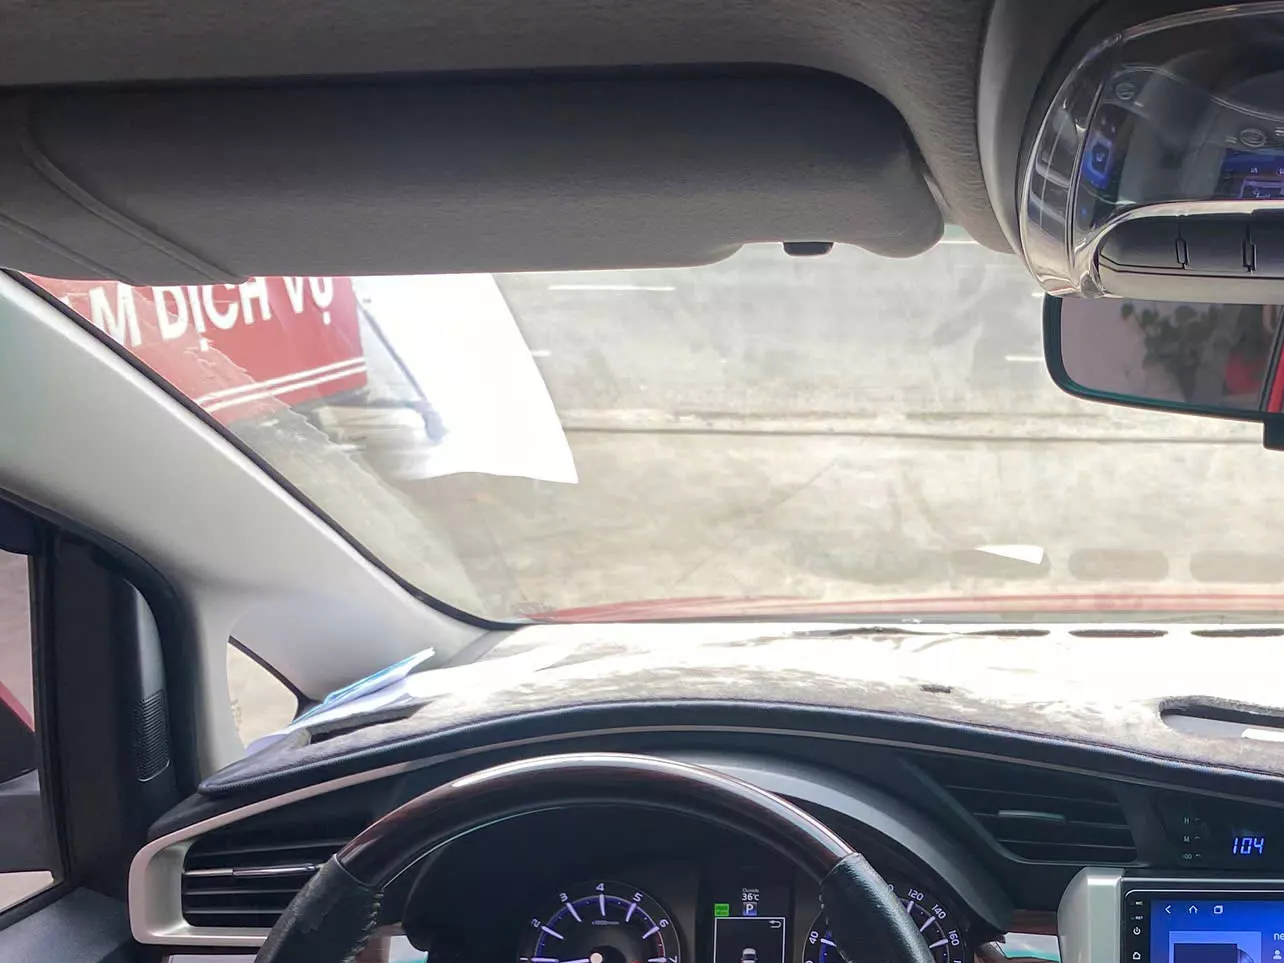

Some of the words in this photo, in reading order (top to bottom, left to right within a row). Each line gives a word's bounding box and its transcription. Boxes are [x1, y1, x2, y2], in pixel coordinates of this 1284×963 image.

[152, 277, 272, 351] DỊCH
[283, 277, 334, 325] VỤ
[1232, 837, 1265, 854] 104
[595, 883, 605, 891] 4
[559, 892, 568, 902] 3
[633, 892, 643, 902] 5
[907, 888, 924, 901] 120
[931, 904, 947, 920] 140
[531, 918, 541, 928] 2
[659, 919, 669, 928] 6
[808, 931, 819, 945] 40
[948, 930, 960, 946] 160
[669, 956, 678, 963] 7
